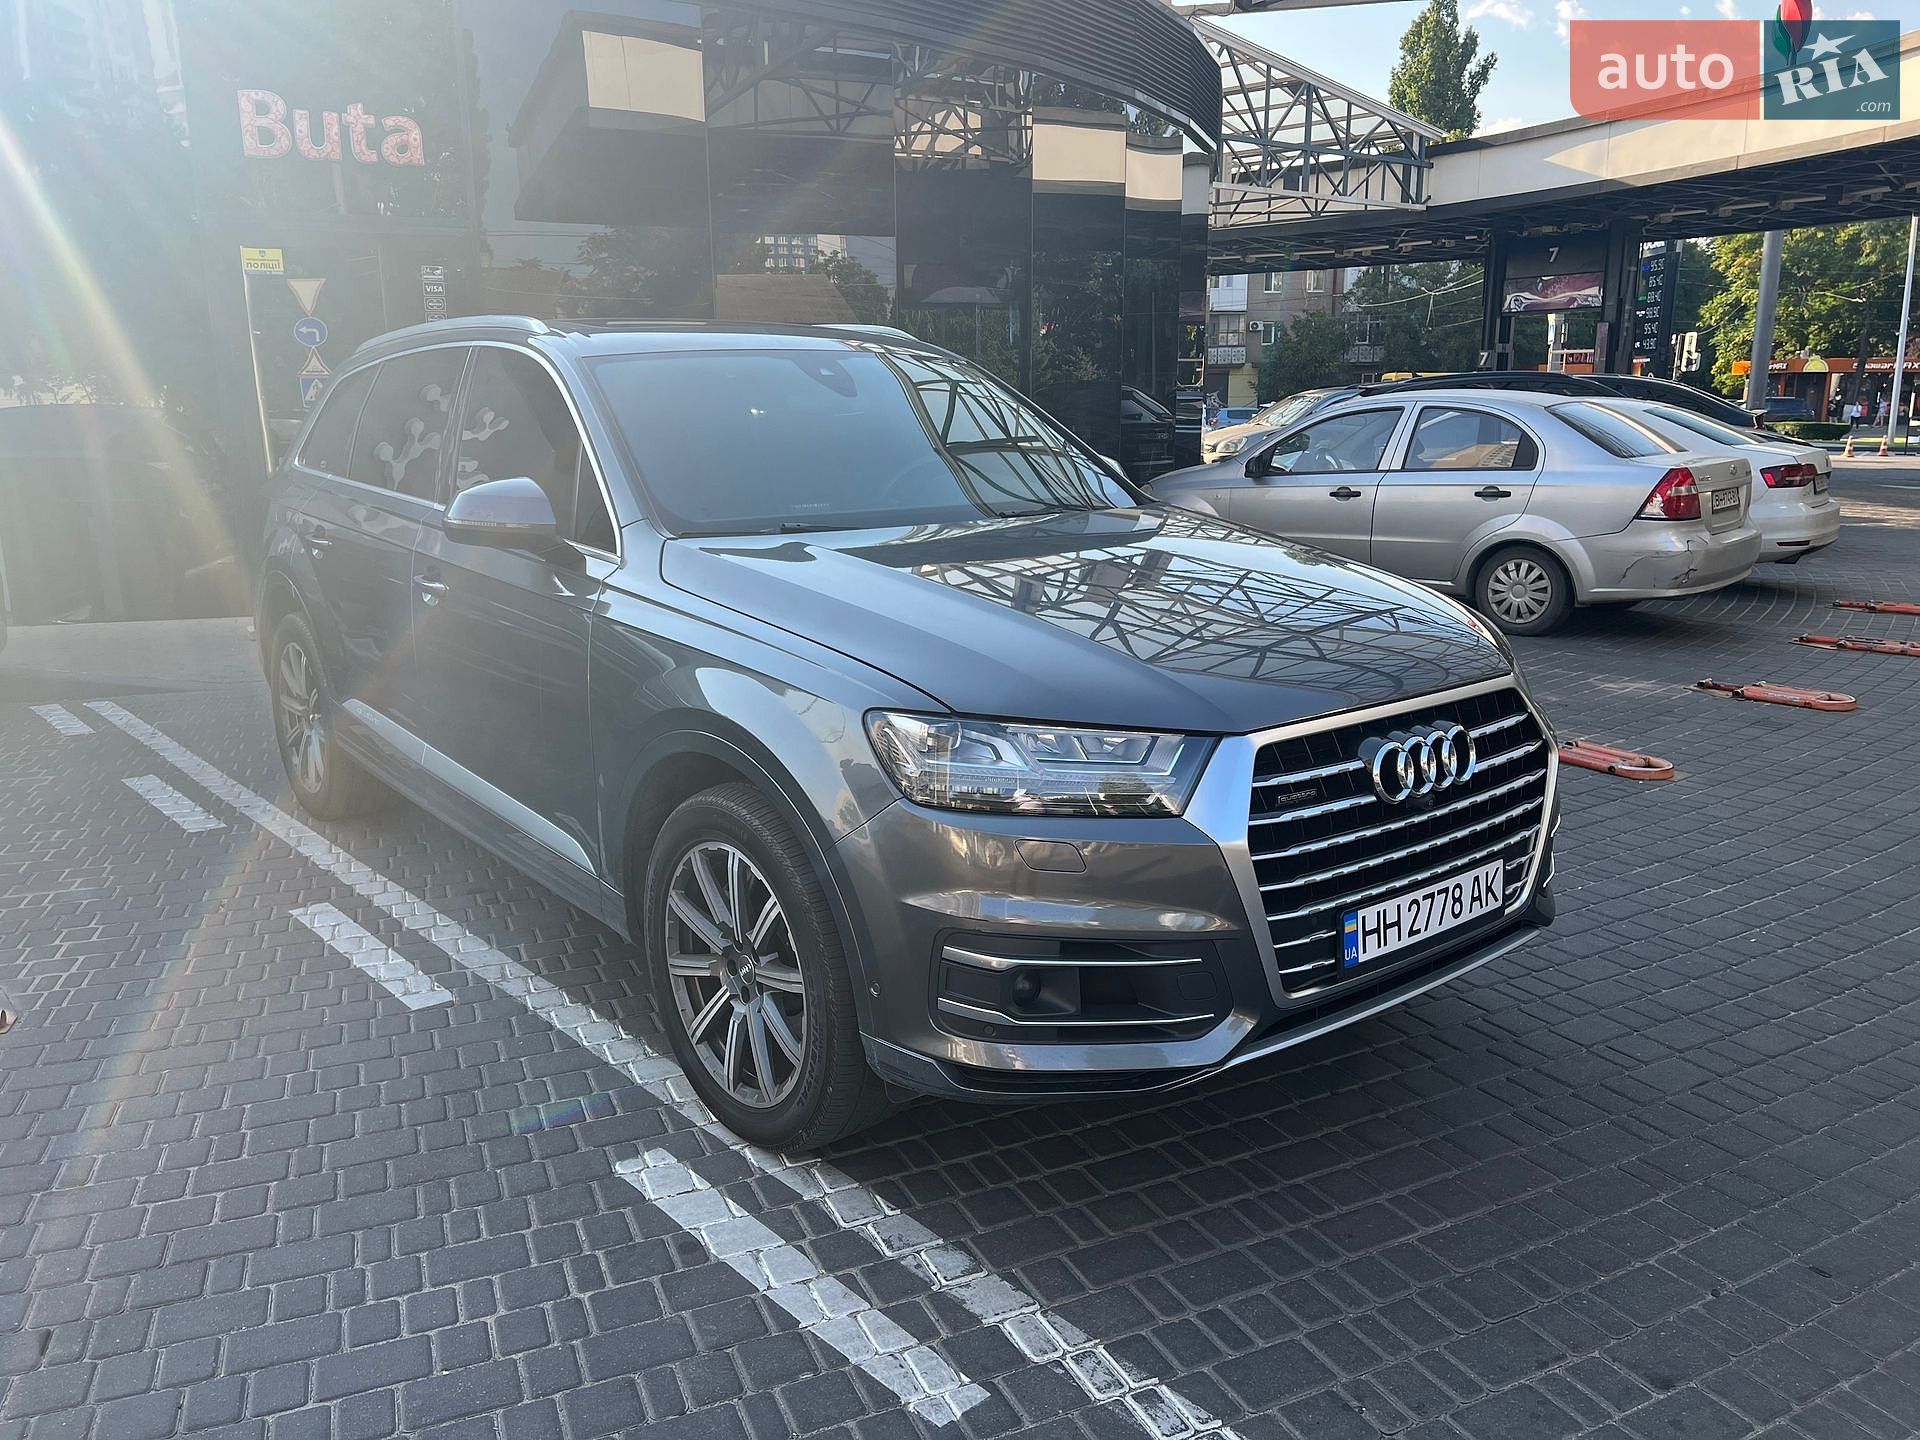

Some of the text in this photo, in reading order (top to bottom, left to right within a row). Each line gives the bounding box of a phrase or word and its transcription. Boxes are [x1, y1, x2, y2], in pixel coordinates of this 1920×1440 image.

[237, 89, 424, 166] Buta
[1549, 247, 1559, 263] 7
[1479, 351, 1489, 366] 7
[1361, 866, 1500, 955] HH 2778 AK
[1344, 948, 1358, 961] UA
